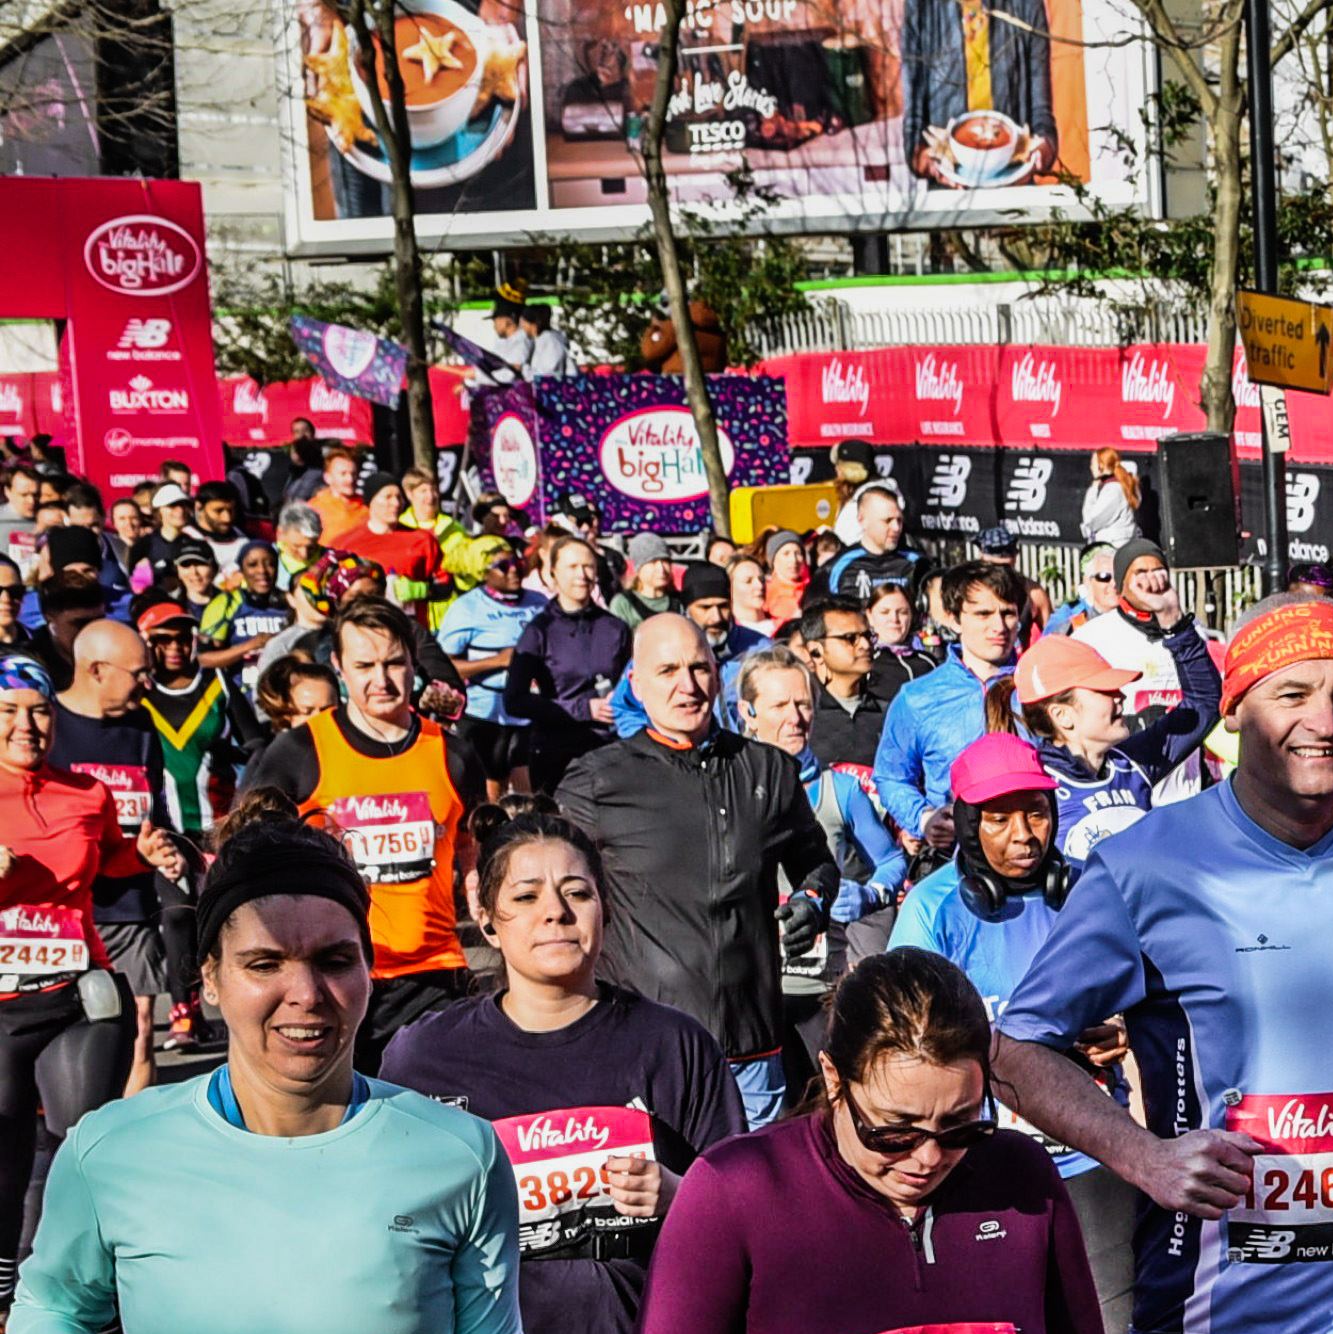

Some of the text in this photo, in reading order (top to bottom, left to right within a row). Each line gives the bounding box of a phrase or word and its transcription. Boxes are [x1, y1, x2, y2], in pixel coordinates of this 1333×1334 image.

[688, 120, 746, 141] TESCO
[1244, 302, 1304, 341] Diverted
[1250, 341, 1296, 371] traffic
[109, 390, 188, 409] BUXTON
[821, 352, 869, 416] Vitality
[915, 351, 963, 415] Vitality
[1011, 351, 1062, 418] Vitality
[1121, 351, 1176, 419] Vitality
[628, 418, 694, 452] Vitality
[517, 1116, 610, 1153] Vitality
[1296, 1244, 1329, 1258] new
